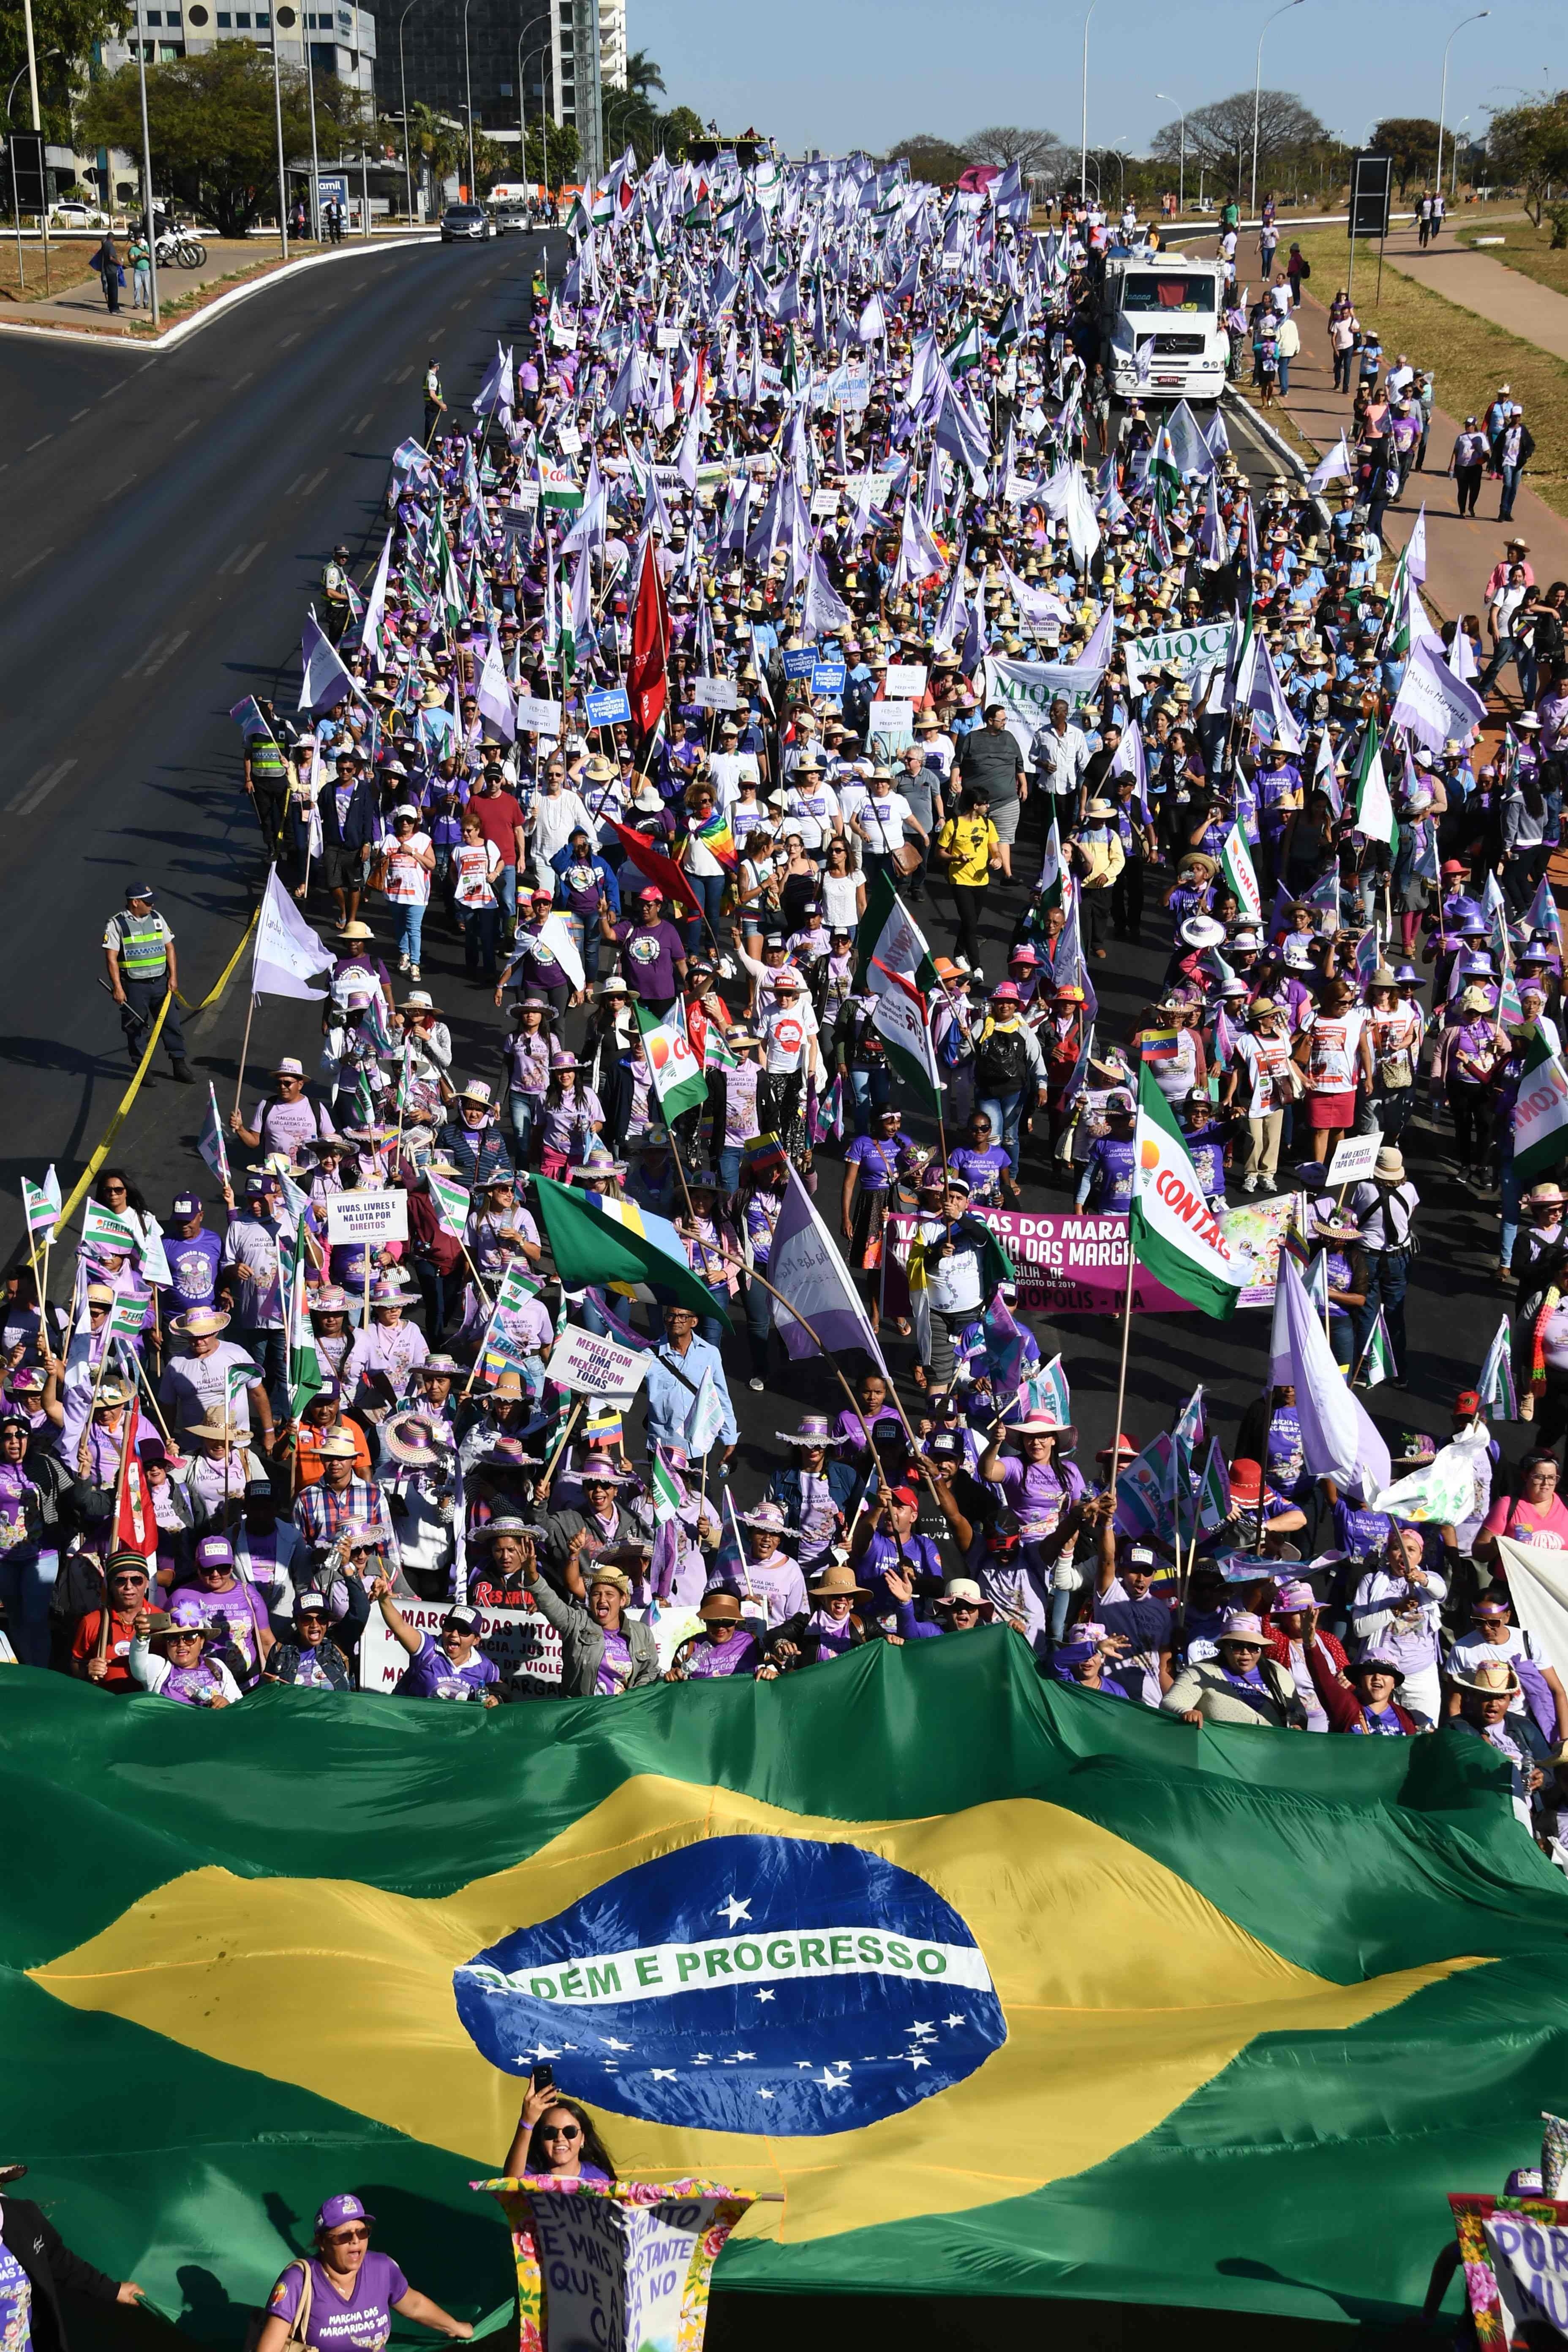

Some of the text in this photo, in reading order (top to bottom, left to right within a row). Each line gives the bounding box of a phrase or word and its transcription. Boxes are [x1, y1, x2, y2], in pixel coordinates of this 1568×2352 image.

[319, 181, 341, 190] amil
[1335, 1160, 1348, 1169] TAPA
[1355, 1156, 1372, 1165] AMOR
[1341, 1148, 1371, 1160] NÃO EXISTE
[337, 1203, 362, 1214] VIVAS,
[363, 1202, 390, 1211] LIVRES
[343, 1211, 391, 1222] NA LUTA POR
[1156, 1170, 1231, 1261] CONTAG
[350, 1221, 386, 1231] DIREITOS
[1020, 1218, 1128, 1241] DO MARA
[1026, 1238, 1064, 1264] DAS
[1014, 1262, 1064, 1279] SÍLIA DF
[1015, 1279, 1045, 1287] AGOSTO
[576, 1337, 633, 1368] MEXEU COM
[588, 1353, 610, 1370] UMA
[569, 1355, 625, 1386] MEXEU COM
[576, 1368, 609, 1390] TODAS
[634, 1955, 663, 1986] E
[675, 1935, 947, 1982] PROGRESSO
[548, 2260, 603, 2300] QUE
[328, 2306, 379, 2325] MARCHA DAS
[319, 2314, 388, 2337] MARGARIDAS 2019
